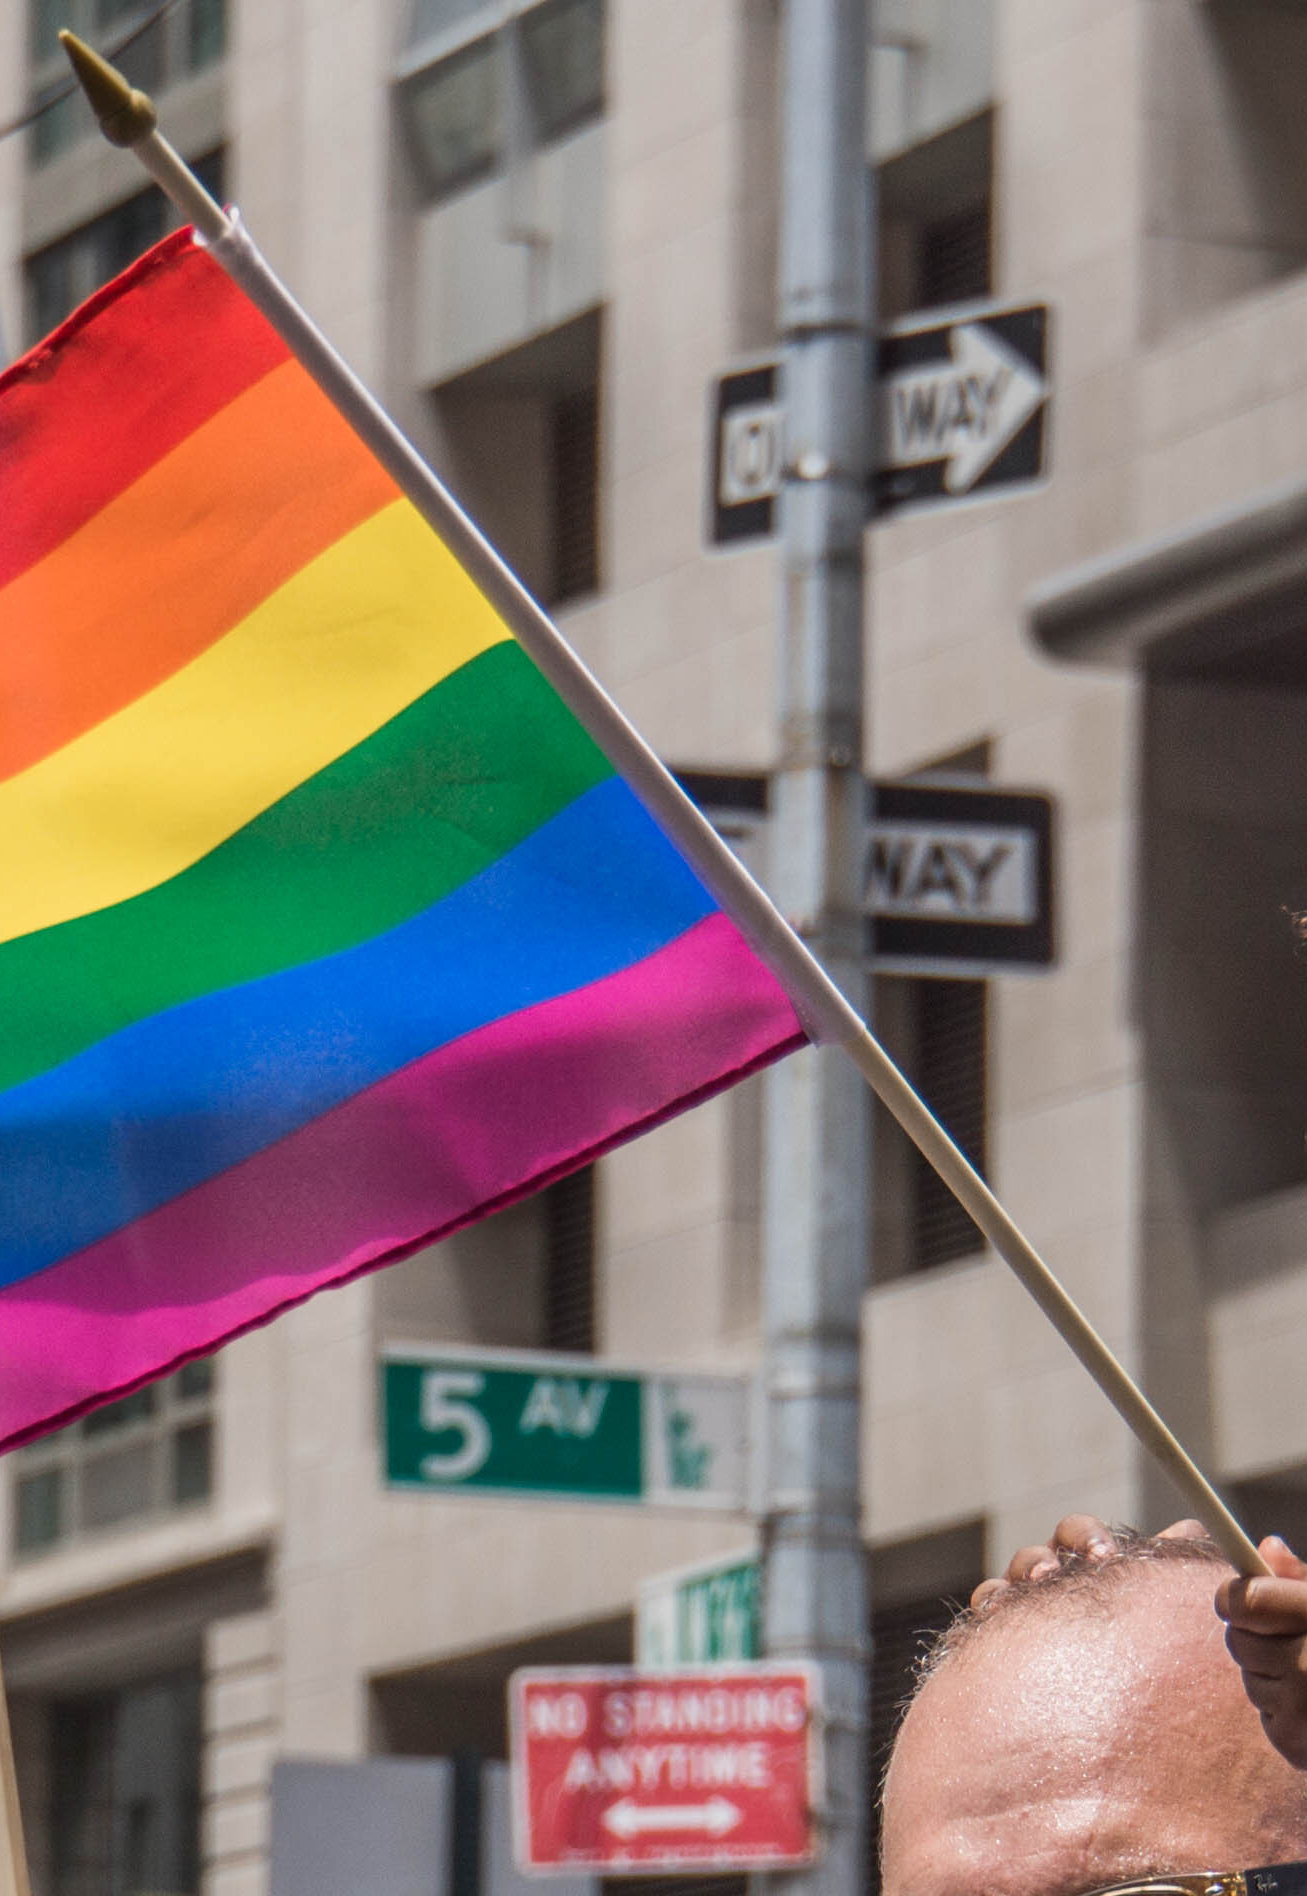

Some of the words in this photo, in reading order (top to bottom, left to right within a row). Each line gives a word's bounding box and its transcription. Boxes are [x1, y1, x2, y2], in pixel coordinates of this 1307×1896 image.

[895, 366, 1013, 450] WAY
[418, 1370, 492, 1481] 5
[519, 1380, 611, 1439] AV
[528, 1692, 588, 1740] NO
[602, 1685, 806, 1737] STANDING
[564, 1741, 772, 1793] ANYTIME
